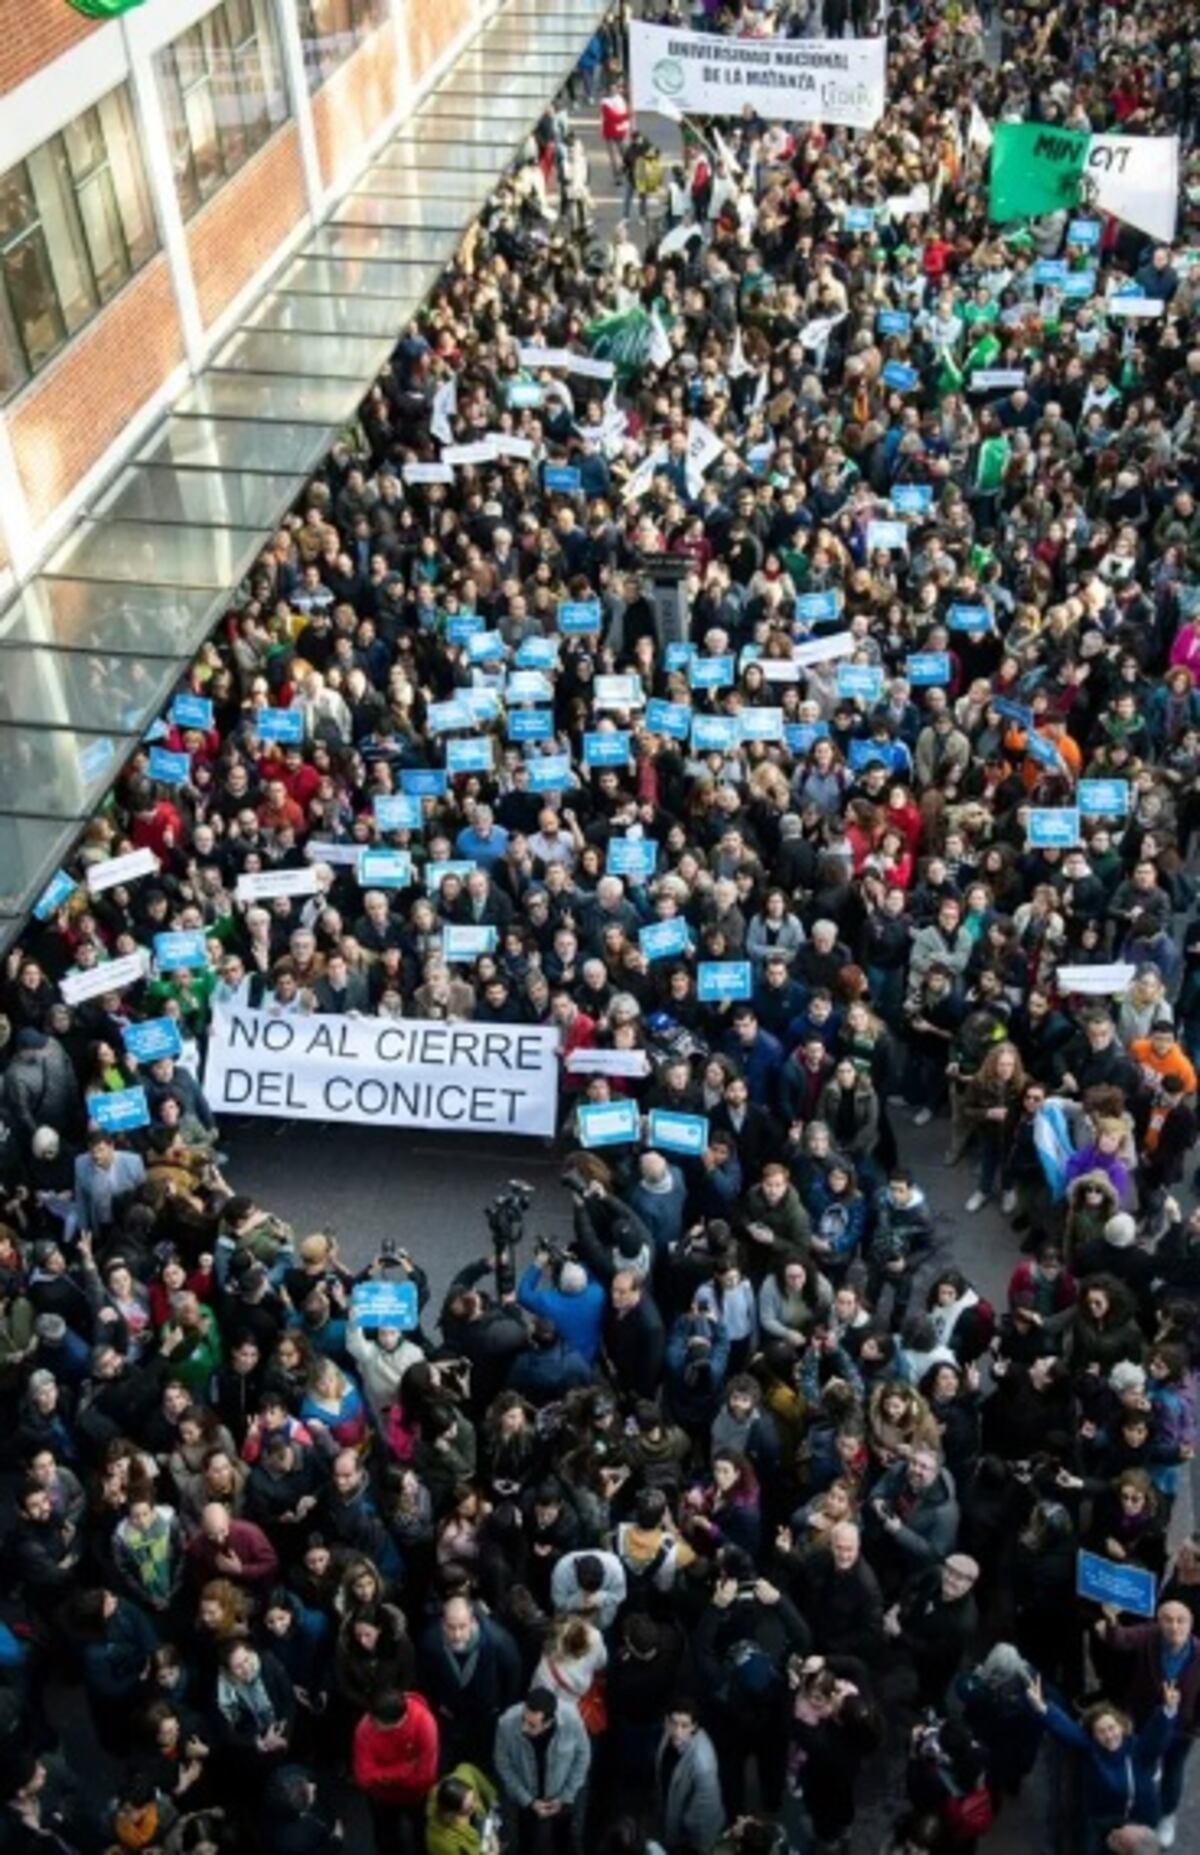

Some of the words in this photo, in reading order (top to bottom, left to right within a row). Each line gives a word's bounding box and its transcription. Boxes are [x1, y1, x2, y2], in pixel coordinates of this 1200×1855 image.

[668, 42, 770, 66] UNIVERSIDAD
[775, 49, 849, 71] NACIONAL
[703, 67, 721, 84] DE
[725, 68, 743, 85] LA
[746, 69, 816, 91] MATANZA
[229, 1016, 294, 1051] NO
[305, 1023, 358, 1058] AL
[375, 1028, 543, 1071] CIERRE
[224, 1068, 307, 1109] DEL
[323, 1076, 527, 1124] CONICET
